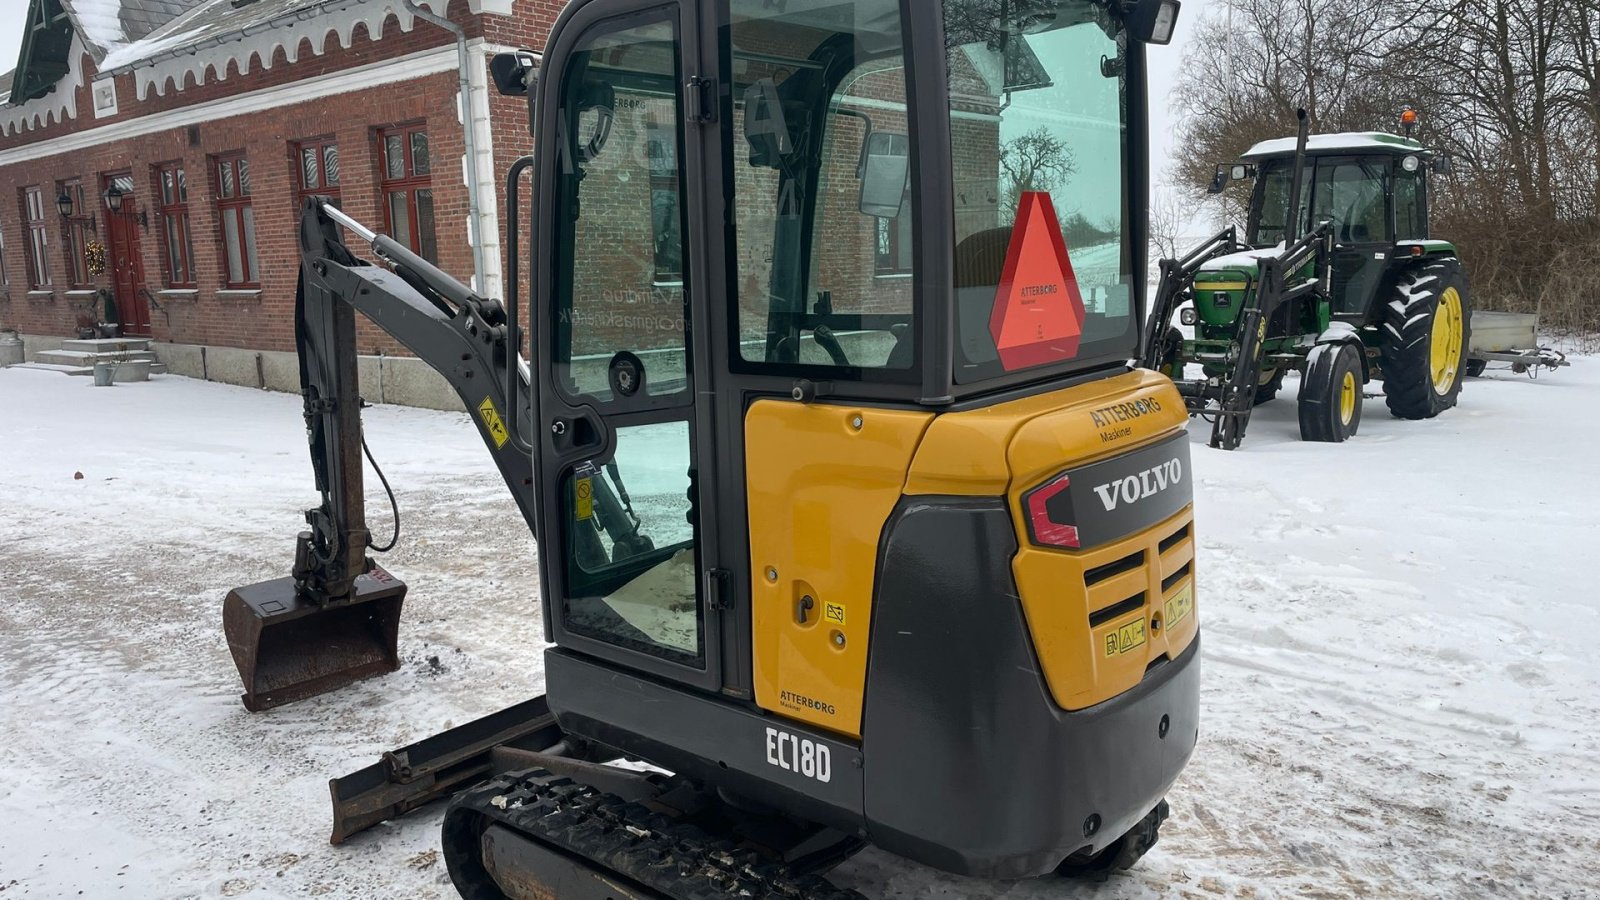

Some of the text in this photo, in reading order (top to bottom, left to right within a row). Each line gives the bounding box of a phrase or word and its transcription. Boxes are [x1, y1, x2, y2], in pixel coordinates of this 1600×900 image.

[614, 97, 646, 110] ERBORG
[1021, 285, 1057, 297] ATTERBORG
[1089, 397, 1162, 428] ATTERBORG
[1100, 427, 1133, 442] Maskiner
[1093, 457, 1182, 512] VOLVO
[780, 690, 836, 715] ATTERBORG
[766, 726, 831, 783] EC18D
